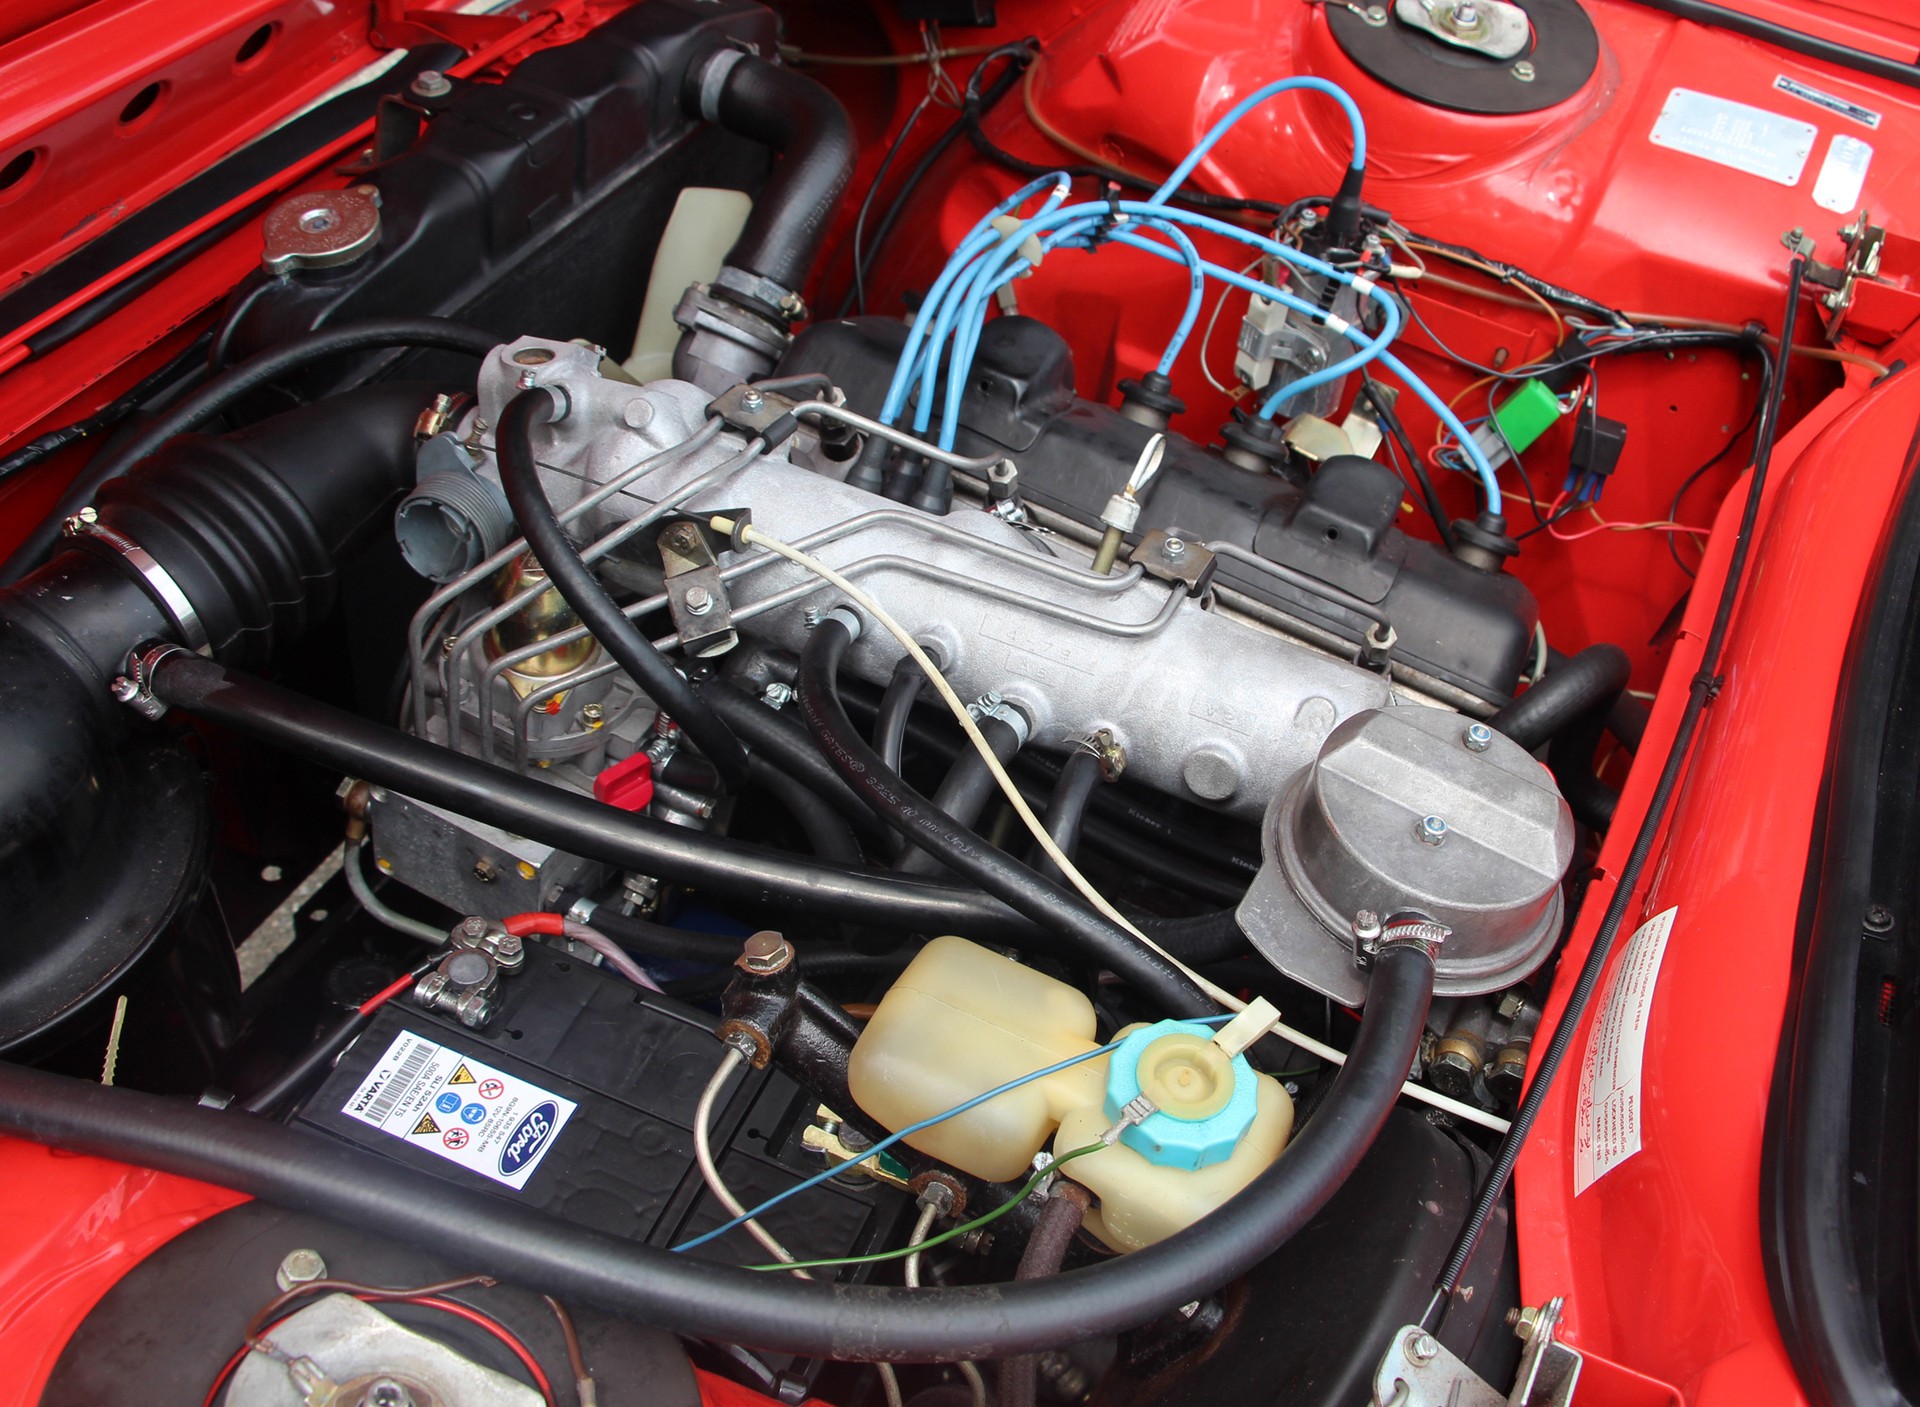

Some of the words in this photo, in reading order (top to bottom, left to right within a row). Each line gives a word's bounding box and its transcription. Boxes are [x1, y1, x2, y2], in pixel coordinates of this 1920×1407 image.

[865, 776, 901, 805] 3225
[420, 1061, 440, 1081] 500A
[428, 1074, 443, 1089] SLI
[353, 1079, 383, 1113] VARTA
[401, 1079, 426, 1107] SAE/EN
[411, 1089, 432, 1113] 52Ah
[490, 1104, 503, 1117] 12V
[501, 1115, 515, 1130] 935
[491, 1130, 506, 1144] 547
[506, 1112, 551, 1163] Ford
